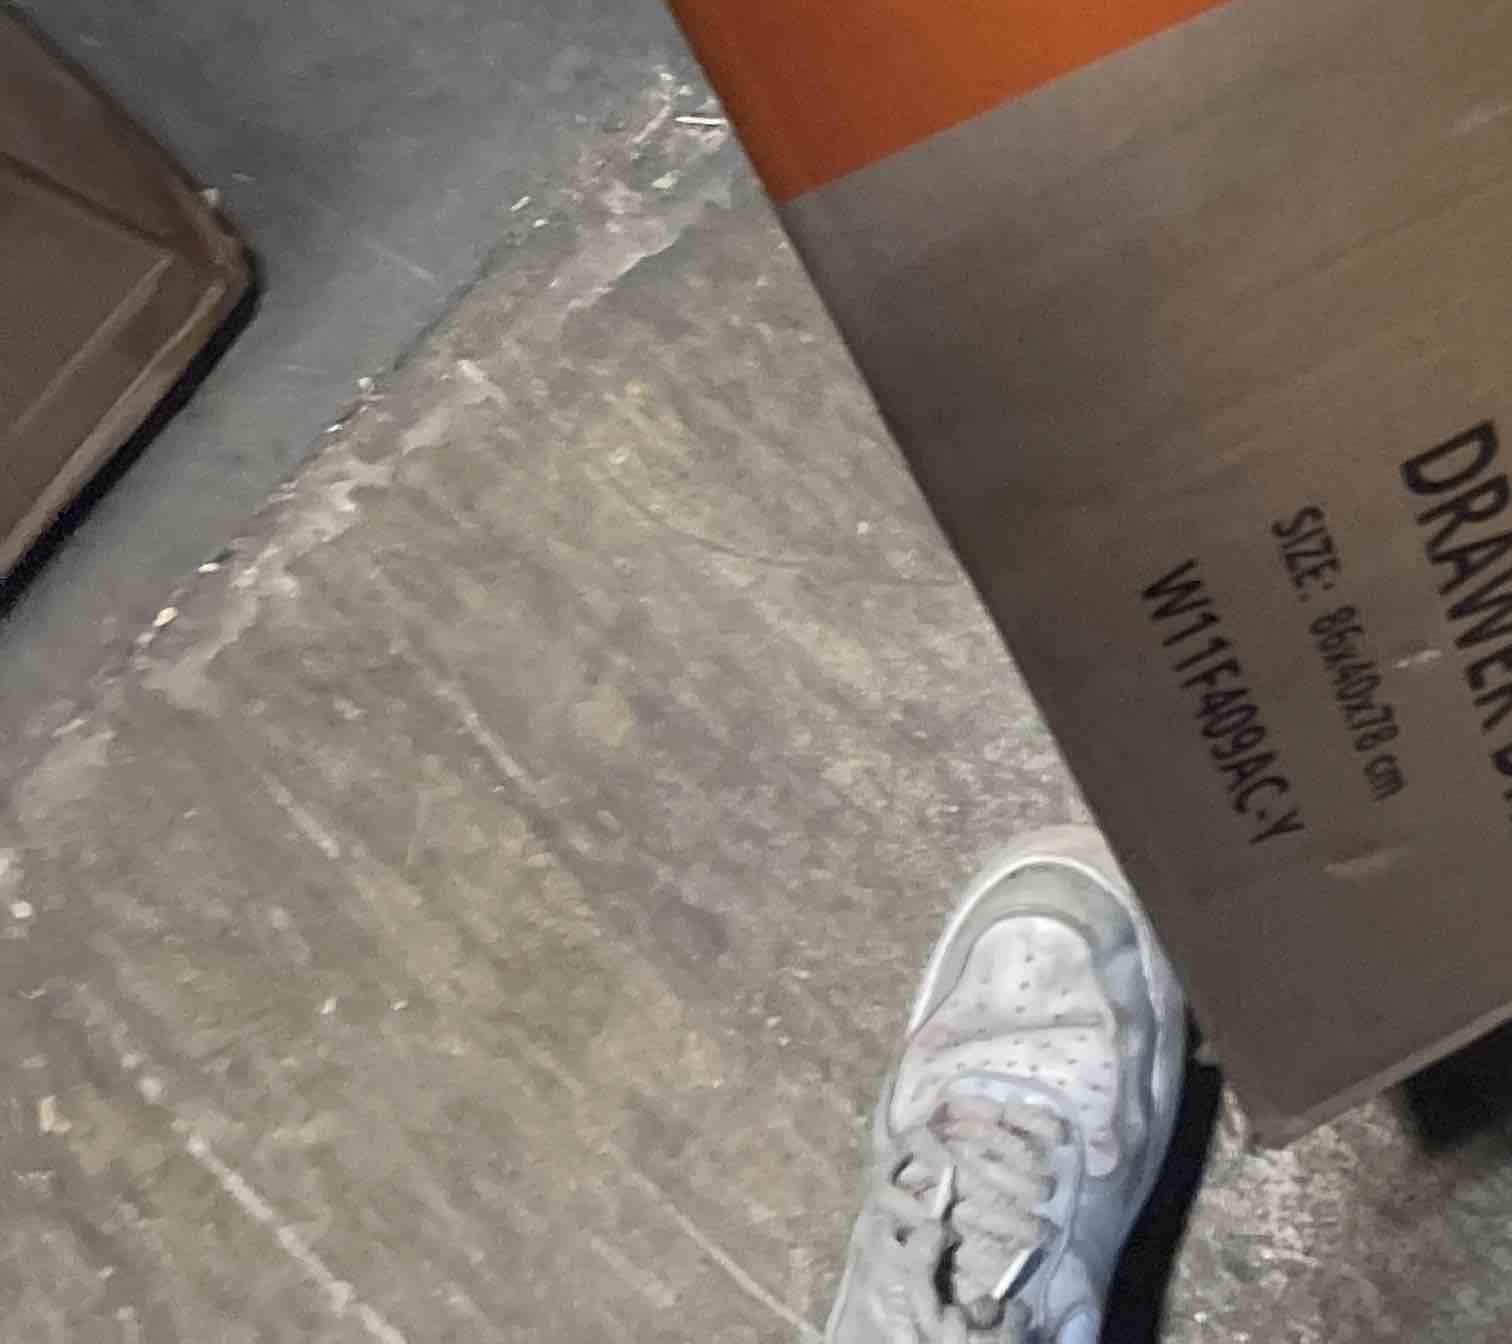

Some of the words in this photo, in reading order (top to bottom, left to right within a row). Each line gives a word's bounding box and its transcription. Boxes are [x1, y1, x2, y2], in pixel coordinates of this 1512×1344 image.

[1141, 557, 1306, 847] W11F409AC-Y
[1271, 506, 1342, 604] SIZE:
[1363, 752, 1406, 802] cm
